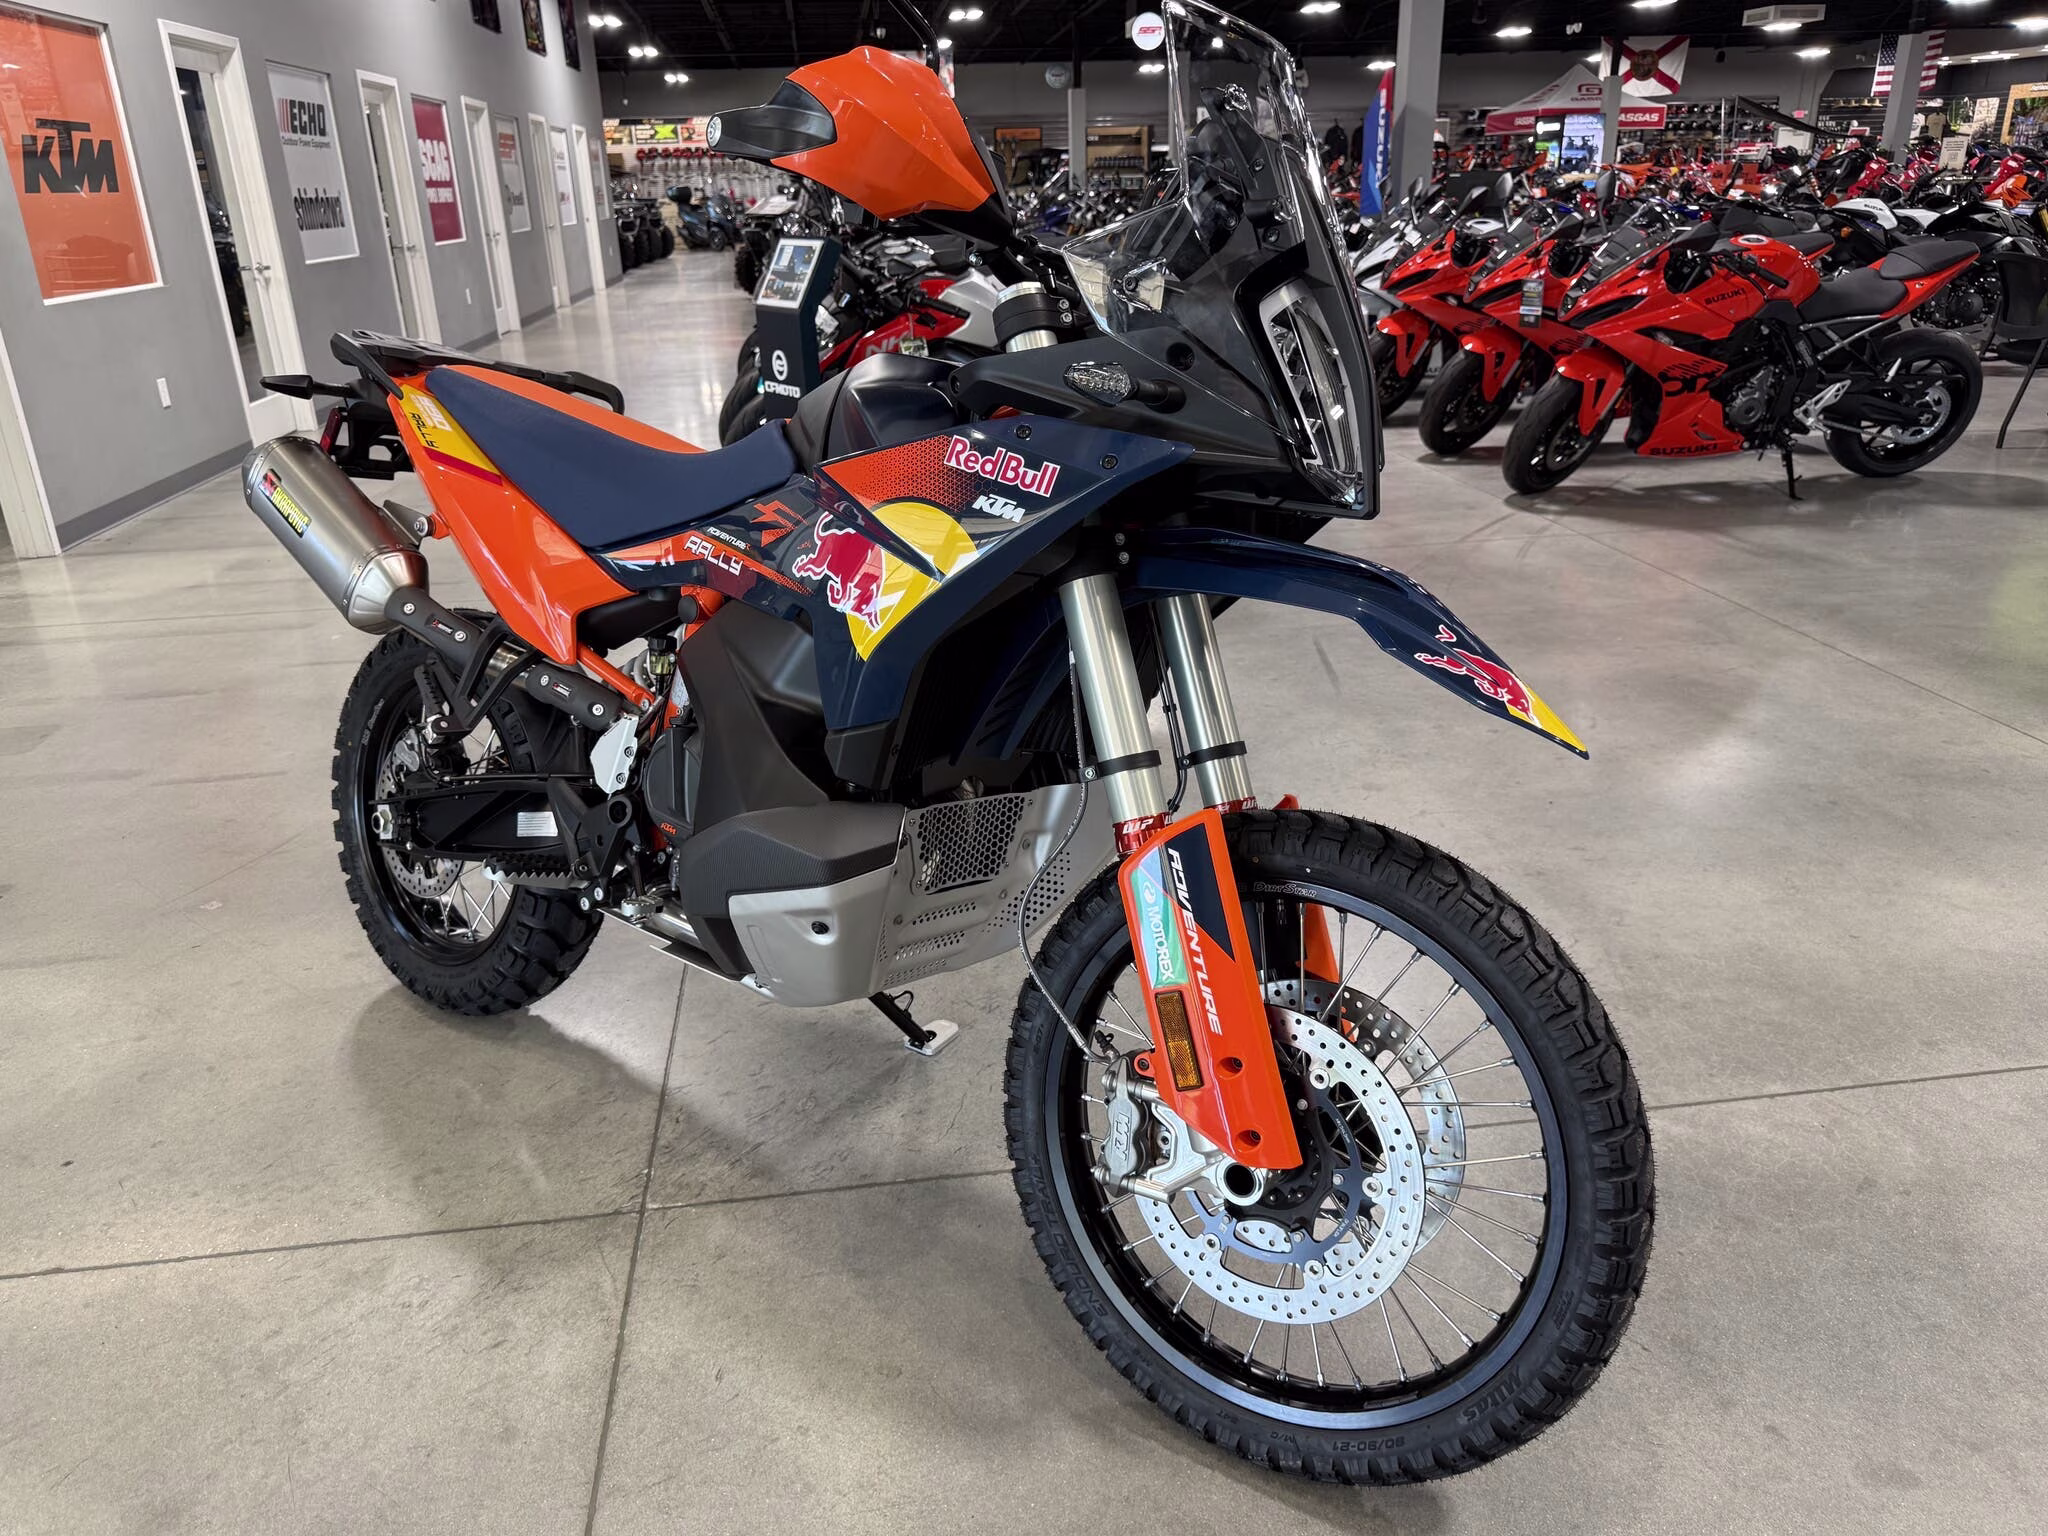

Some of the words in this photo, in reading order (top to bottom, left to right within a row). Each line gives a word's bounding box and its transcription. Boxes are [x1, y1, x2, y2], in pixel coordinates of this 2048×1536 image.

[289, 99, 327, 137] ECHO
[1619, 113, 1660, 122] ASGAS
[22, 118, 119, 194] KTM
[418, 138, 451, 182] SCAG
[1704, 287, 1746, 305] SUZUKI
[764, 380, 801, 399] CFMOTO
[409, 411, 440, 449] RALLY
[1651, 443, 1719, 455] SUZUKI
[943, 435, 1006, 480] Red
[997, 452, 1061, 498] Bull
[972, 493, 1026, 523] KTM
[684, 535, 744, 577] RALLY
[706, 526, 746, 550] ADVENTURE
[1122, 818, 1154, 835] WP
[1147, 905, 1176, 983] MOTOREX
[1167, 847, 1223, 1036] ADVENTURE
[1053, 1232, 1109, 1318] ENDURO
